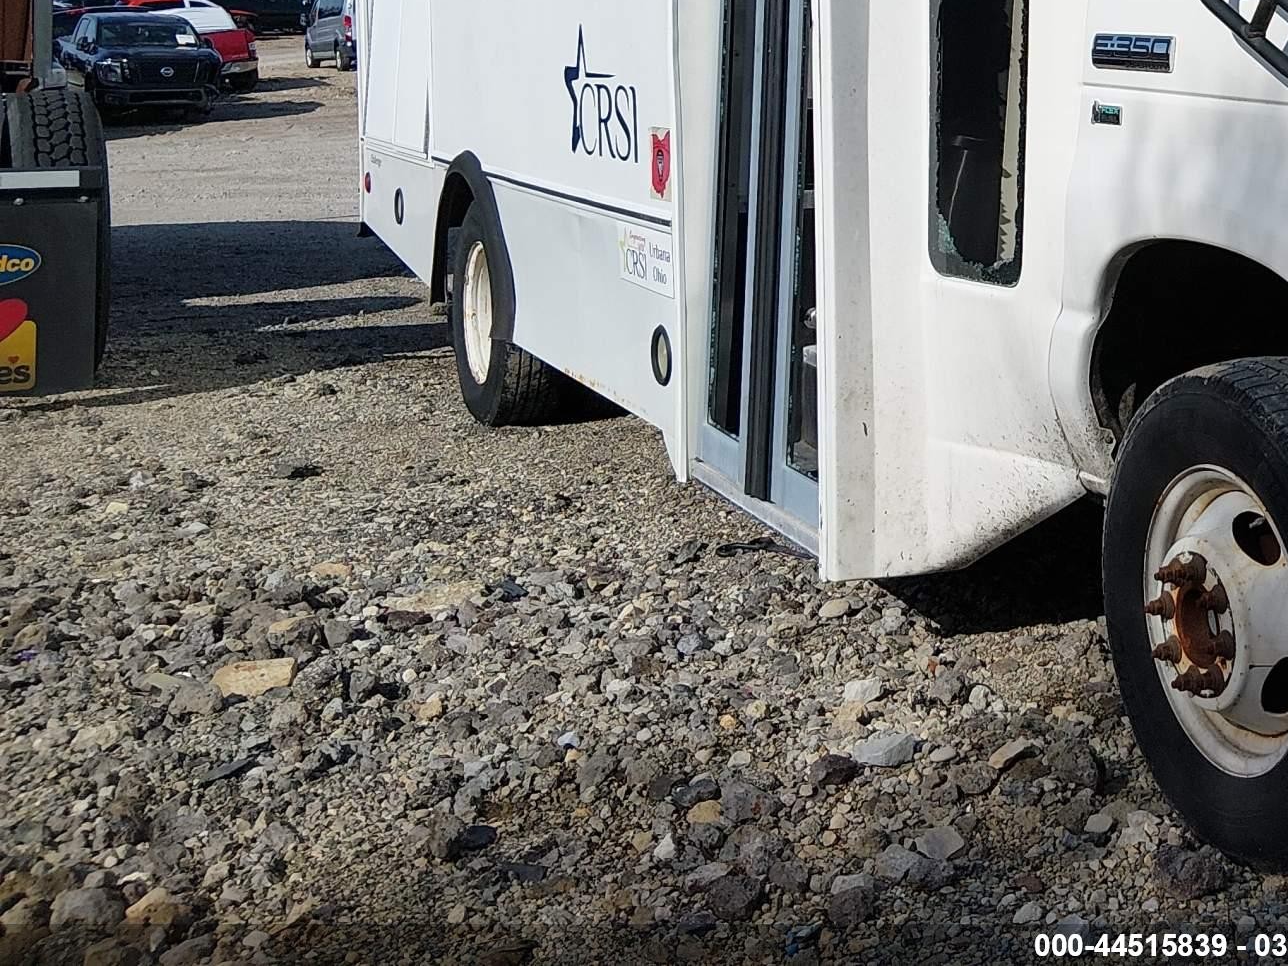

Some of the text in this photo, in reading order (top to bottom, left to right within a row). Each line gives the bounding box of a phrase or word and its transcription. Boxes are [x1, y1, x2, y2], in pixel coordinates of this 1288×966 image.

[579, 82, 638, 164] CRSI
[625, 248, 648, 281] CRSI
[649, 241, 671, 263] Urbana
[653, 265, 668, 285] Ohio
